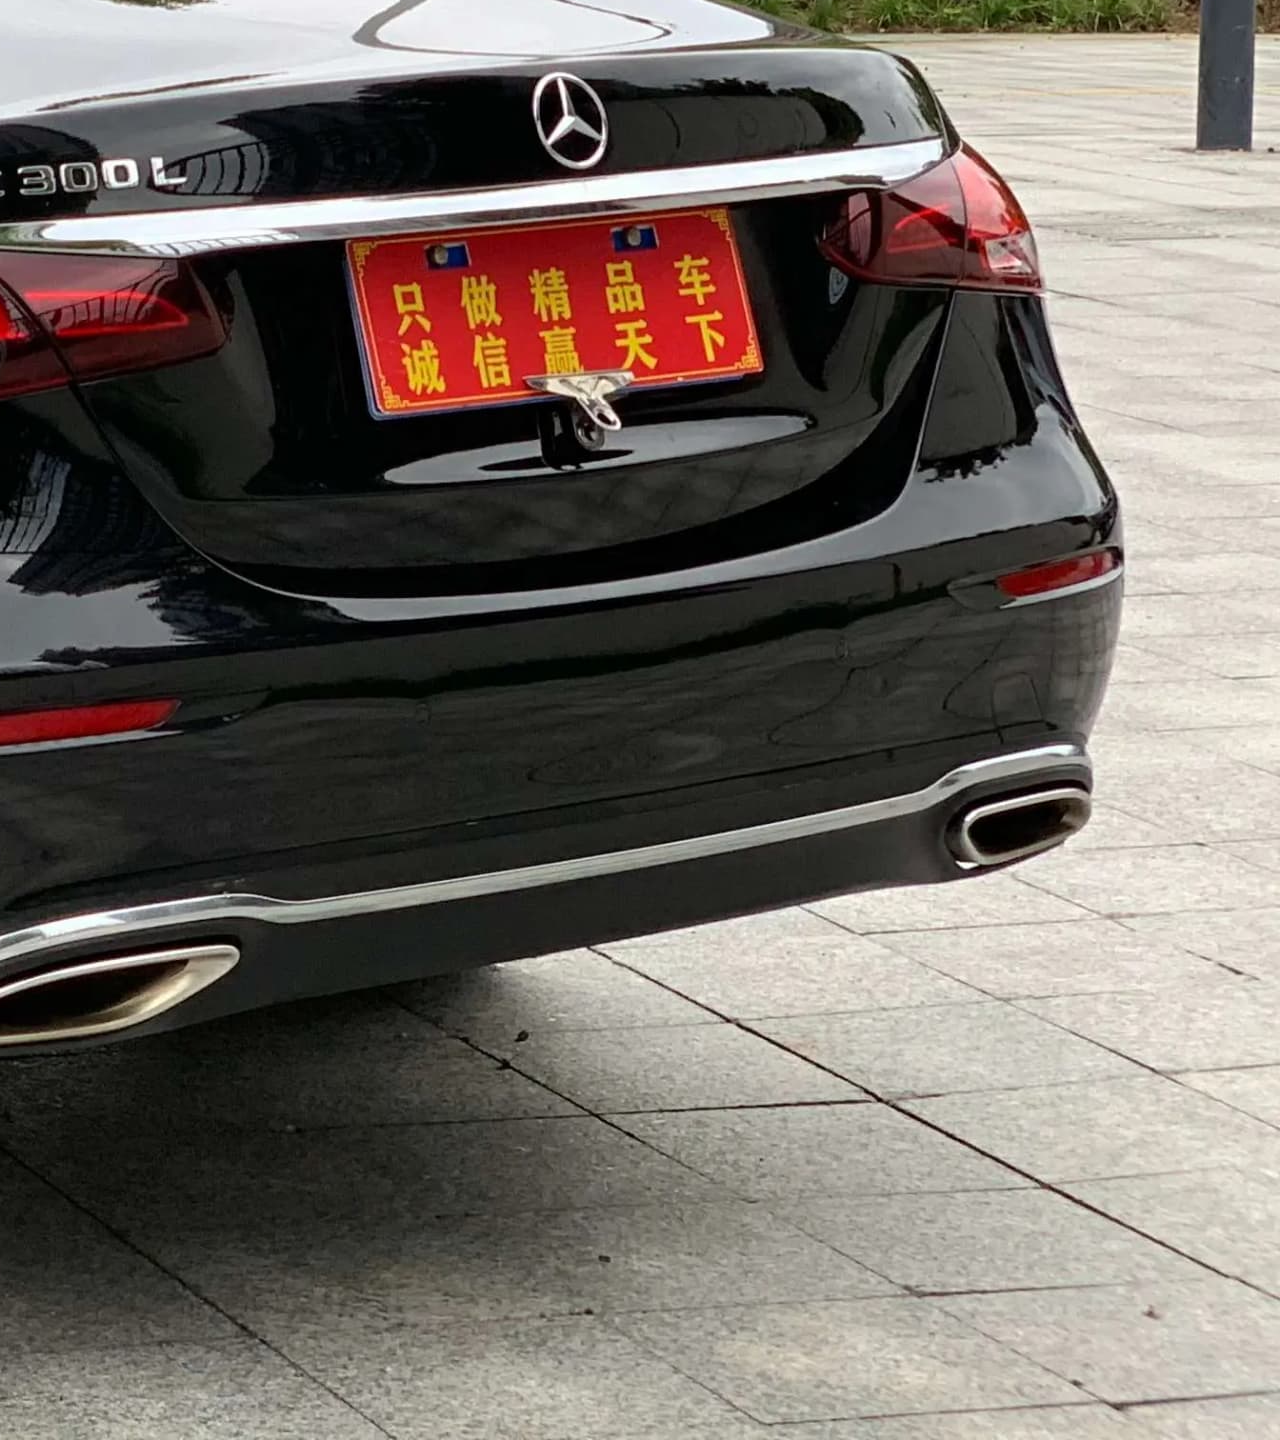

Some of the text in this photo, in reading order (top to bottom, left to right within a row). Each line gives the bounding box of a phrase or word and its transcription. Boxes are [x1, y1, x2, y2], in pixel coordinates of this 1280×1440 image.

[391, 253, 717, 337] 只做精品车
[401, 309, 726, 396] 诚信赢天下
